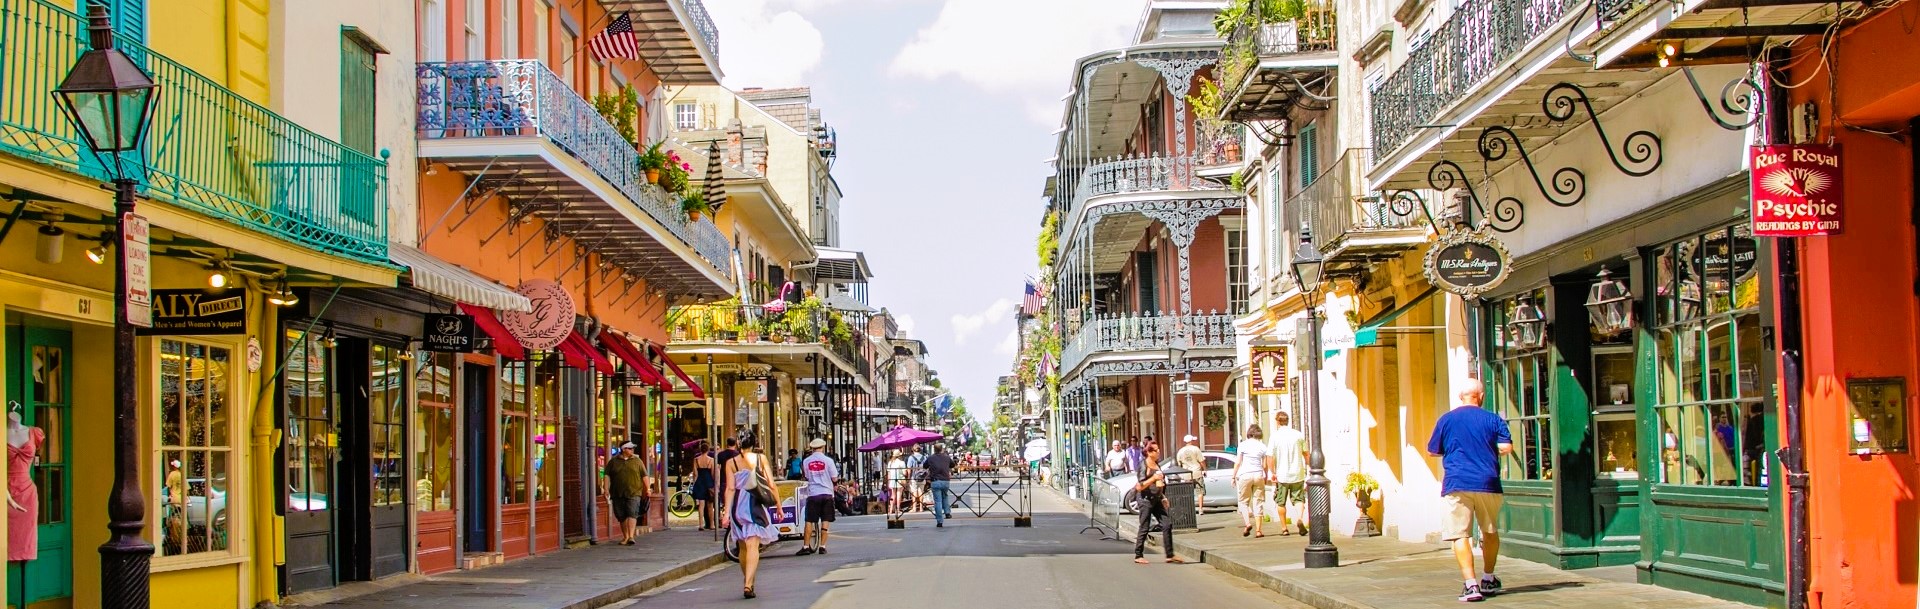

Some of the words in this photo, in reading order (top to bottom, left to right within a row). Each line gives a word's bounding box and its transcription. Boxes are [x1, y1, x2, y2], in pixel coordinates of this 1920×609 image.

[1755, 153, 1787, 170] Rue
[1792, 148, 1838, 168] Royal
[1756, 198, 1838, 219] Psychic
[1756, 221, 1800, 230] READINGS
[1802, 221, 1816, 230] BY
[1817, 220, 1839, 230] GINA
[129, 246, 147, 262] LOADING
[133, 263, 145, 277] ZONE
[1470, 257, 1498, 272] Antiques
[78, 298, 91, 315] 631
[151, 293, 202, 318] ALY
[201, 299, 240, 315] DIRECT
[217, 320, 242, 329] Apparel
[428, 334, 468, 346] NAGHI'S
[509, 328, 535, 349] FISCHER
[538, 329, 569, 349] GAMBINO
